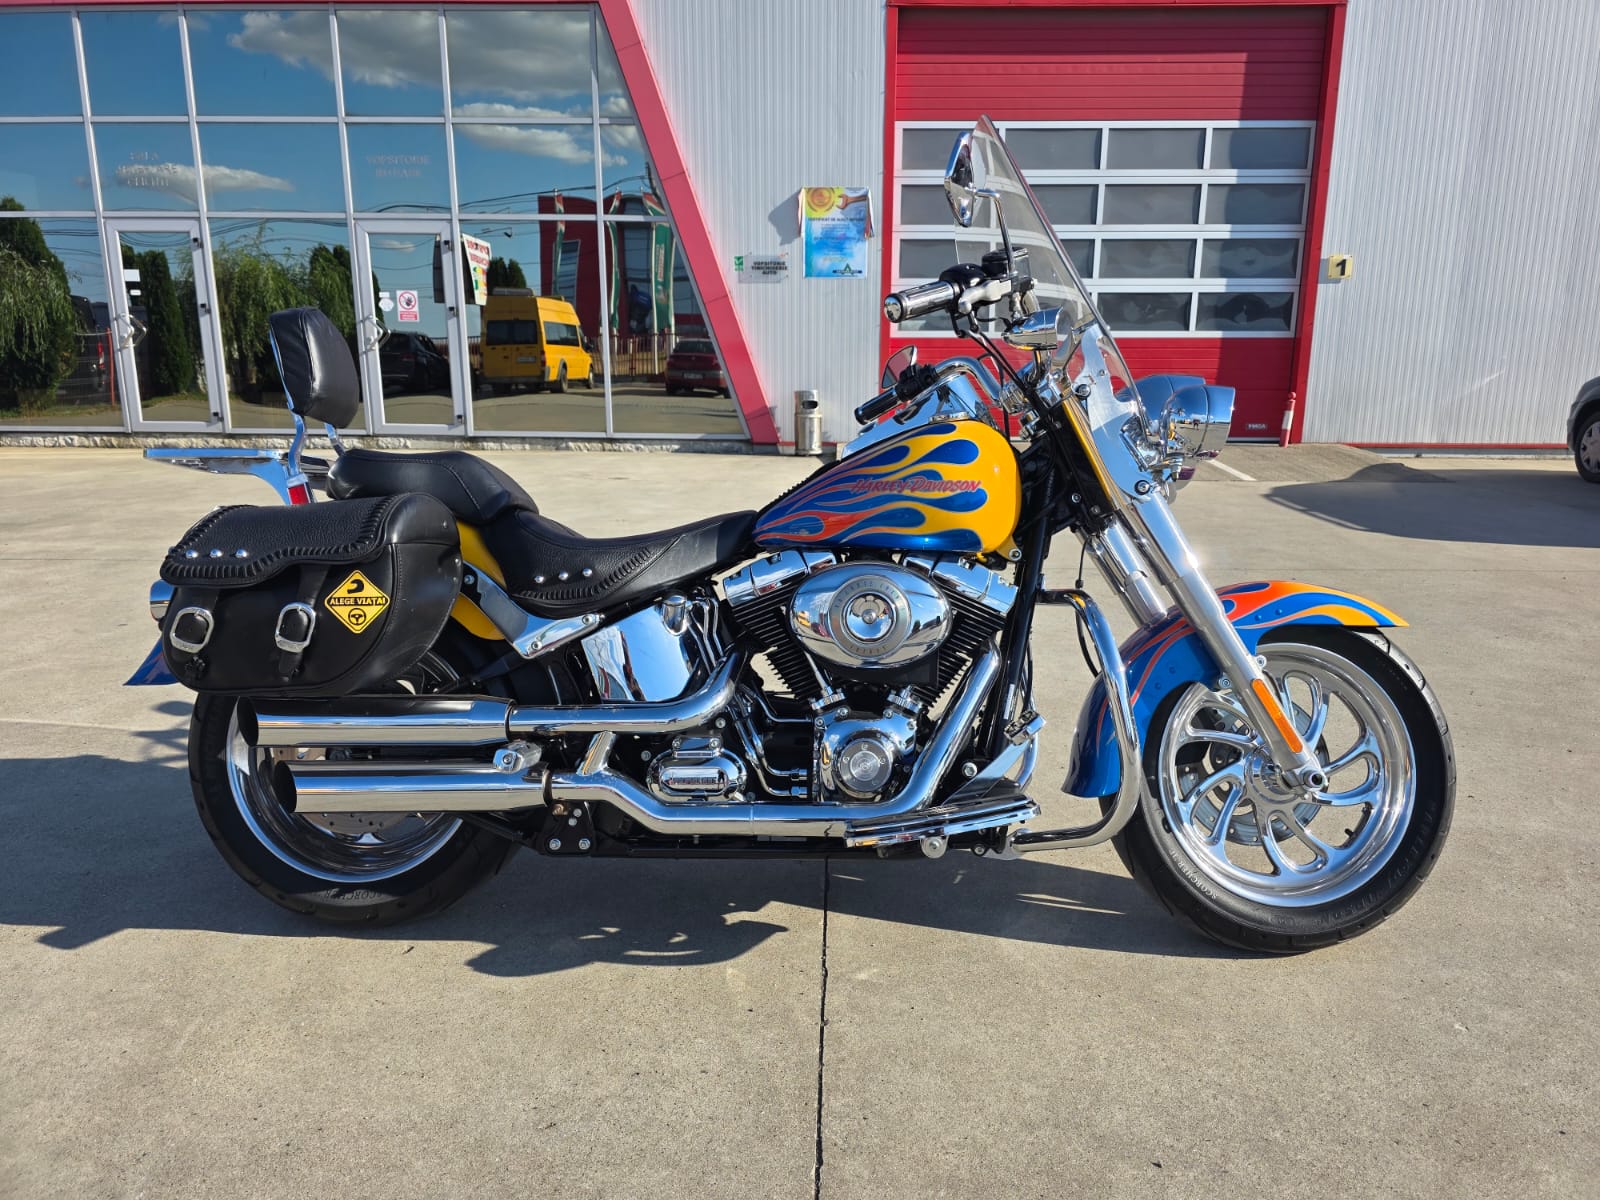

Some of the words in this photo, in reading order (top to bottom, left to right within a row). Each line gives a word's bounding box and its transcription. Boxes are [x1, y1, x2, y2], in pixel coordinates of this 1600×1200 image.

[1336, 259, 1346, 276] 1
[851, 476, 981, 492] HARLEY-DAVIDSON
[329, 597, 356, 605] ALEGE
[1177, 861, 1218, 899] SCORCHER
